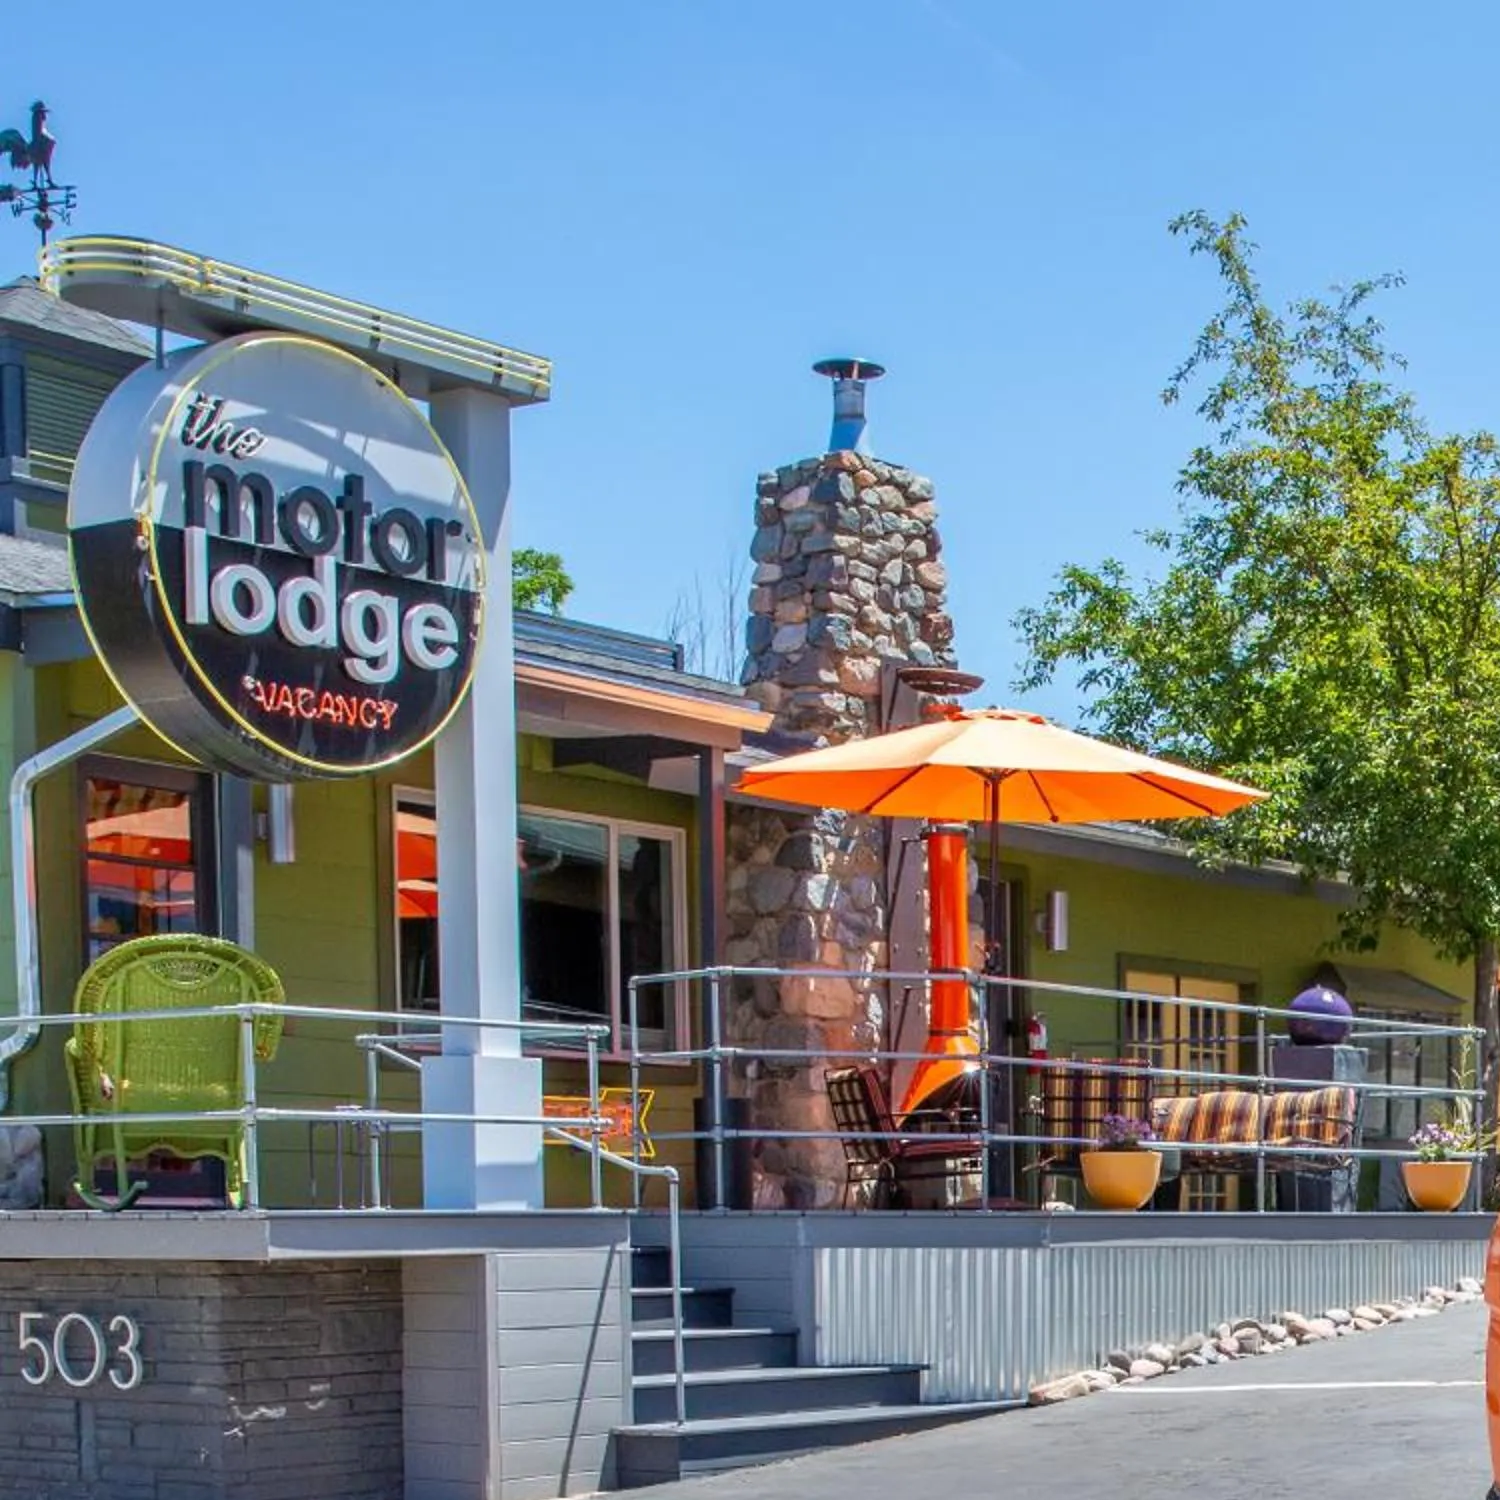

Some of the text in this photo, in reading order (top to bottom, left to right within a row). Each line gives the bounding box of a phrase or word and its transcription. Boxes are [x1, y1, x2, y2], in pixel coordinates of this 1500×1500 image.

[183, 392, 269, 459] the
[184, 459, 463, 581] motor
[184, 526, 460, 684] lodge
[254, 680, 399, 730] VACANCY
[19, 1311, 143, 1390] 503
